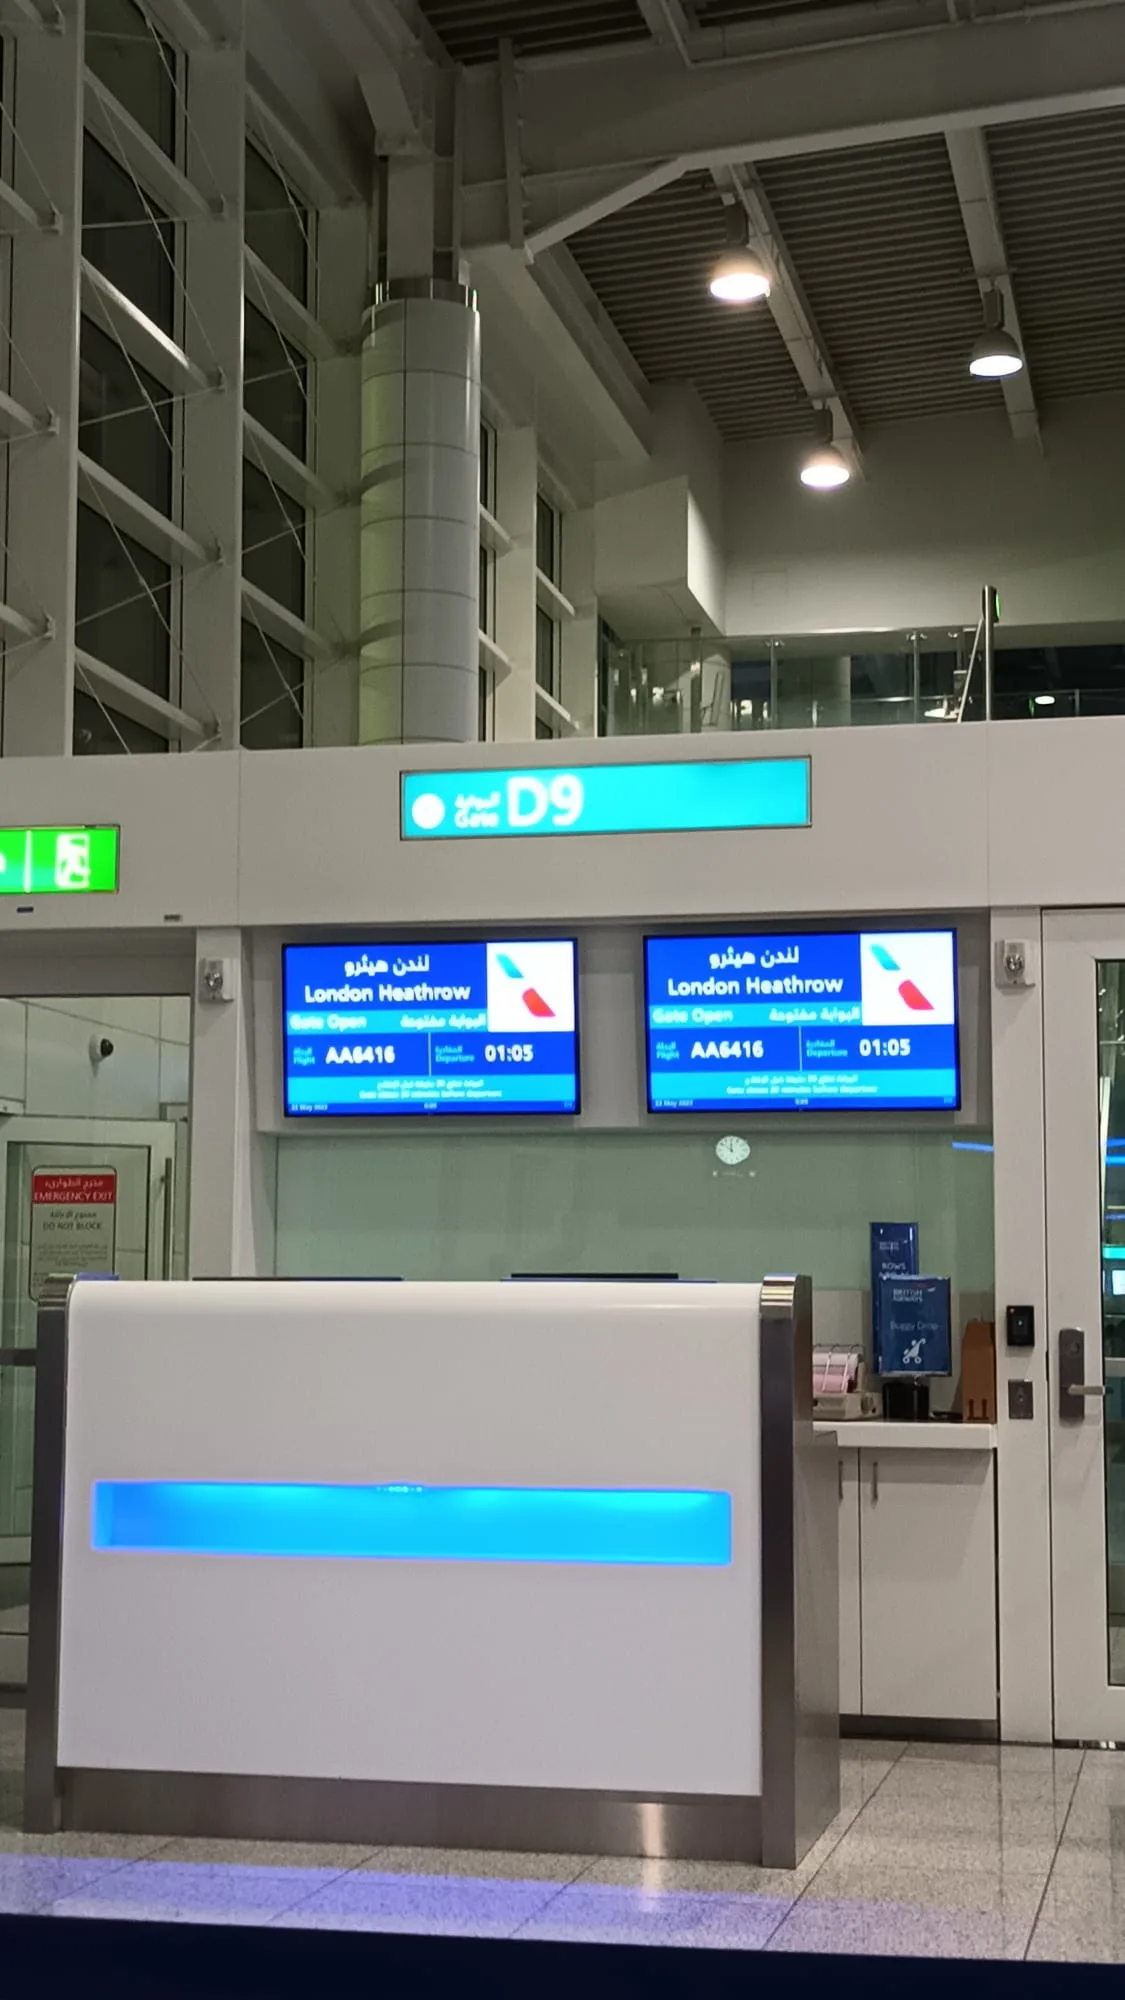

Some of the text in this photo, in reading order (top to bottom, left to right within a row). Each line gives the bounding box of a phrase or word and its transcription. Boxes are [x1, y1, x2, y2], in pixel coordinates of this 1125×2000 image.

[506, 774, 584, 827] D9
[455, 810, 499, 828] Gate
[344, 953, 430, 978] لندن هيثرو
[709, 946, 800, 969] لندن هيثرو
[304, 982, 471, 1003] London Heathrow
[668, 975, 844, 997] London Heathrow
[289, 1012, 367, 1032] Gate Open
[652, 1006, 733, 1026] Gate Open
[325, 1045, 396, 1065] AA6416
[484, 1044, 534, 1063] 01:05
[656, 1049, 680, 1061] Flight
[691, 1040, 764, 1059] AA6416
[806, 1048, 848, 1058] Departure
[859, 1038, 911, 1057] 01:05
[293, 1055, 316, 1066] Flight
[435, 1054, 475, 1064] Departure
[34, 1191, 113, 1201] EMERGENCY EXIT
[43, 1221, 103, 1230] DO NOT BLOCK
[890, 1321, 915, 1331] Buggy
